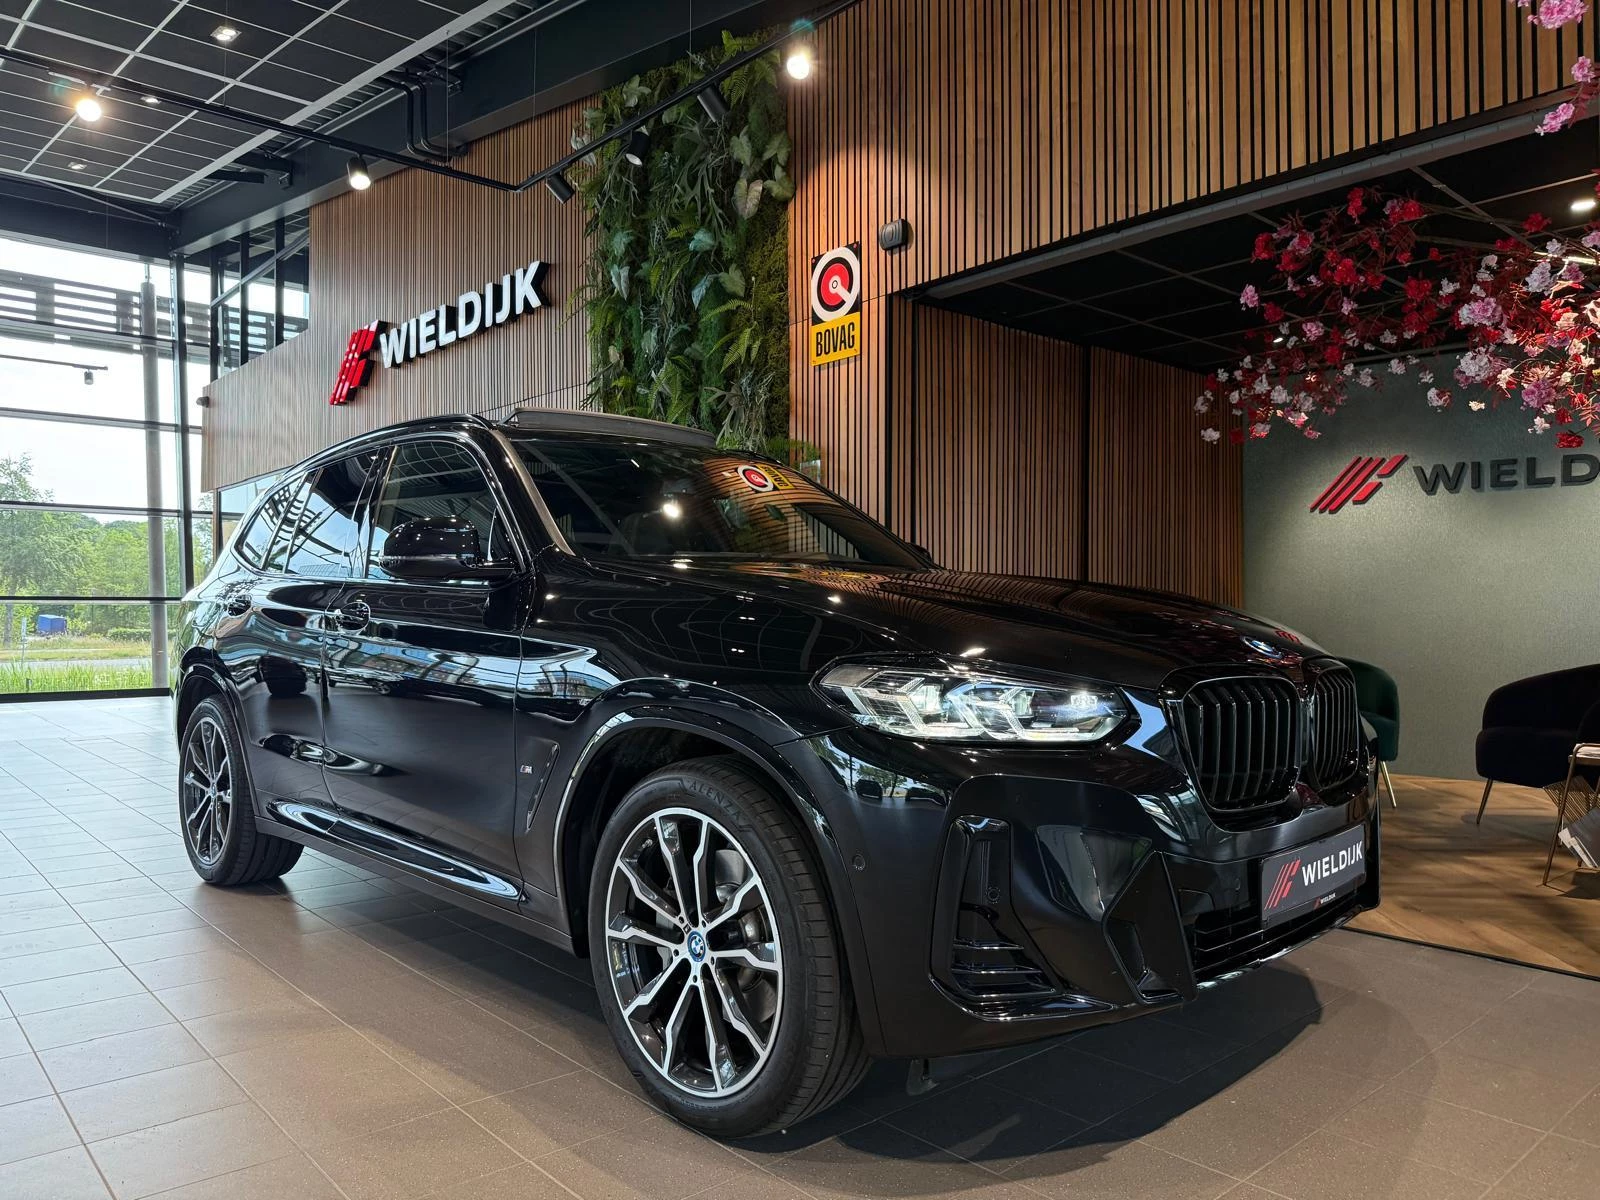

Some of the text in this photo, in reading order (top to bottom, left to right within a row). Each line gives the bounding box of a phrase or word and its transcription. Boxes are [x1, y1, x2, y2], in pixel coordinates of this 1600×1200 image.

[379, 260, 542, 369] WIELDIJK
[815, 321, 855, 357] BOVAG
[1412, 454, 1600, 497] WIELD
[1302, 841, 1363, 886] WIELDIJK
